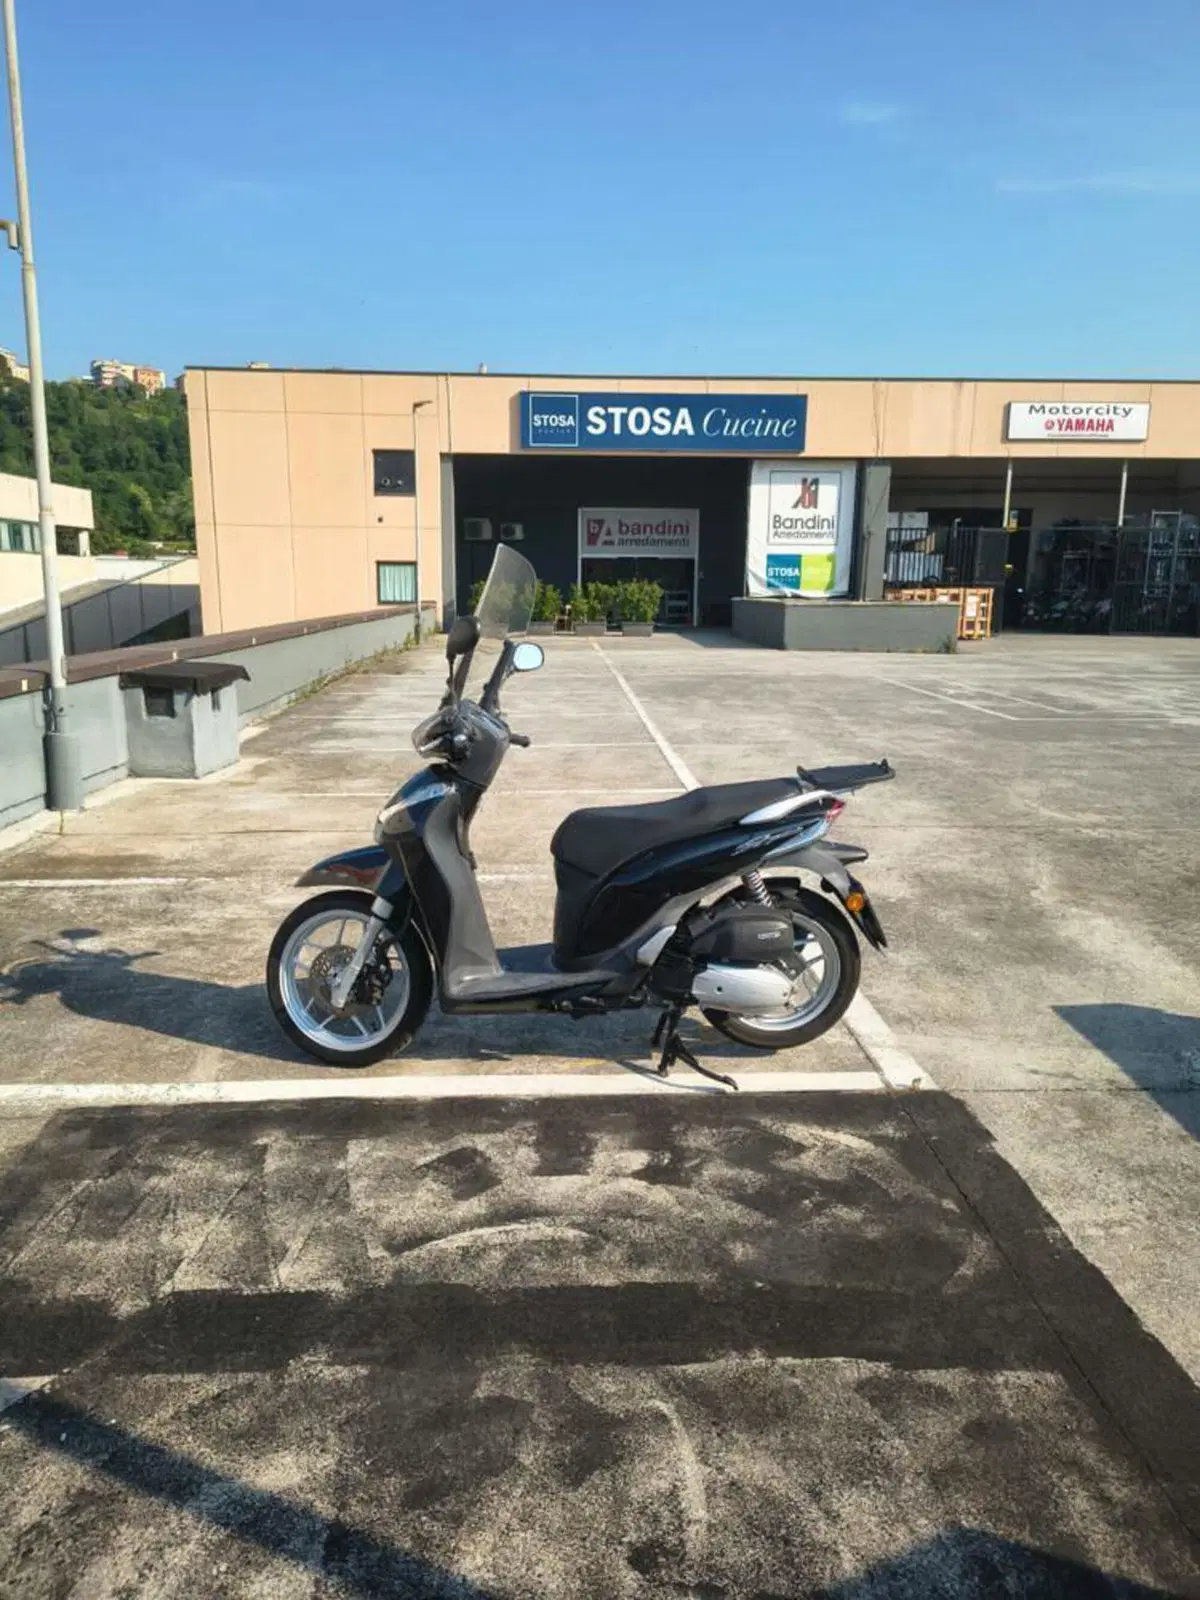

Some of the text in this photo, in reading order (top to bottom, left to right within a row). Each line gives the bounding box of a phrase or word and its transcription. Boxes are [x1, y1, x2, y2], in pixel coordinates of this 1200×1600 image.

[1028, 404, 1133, 418] Motorcity
[533, 414, 576, 427] STOSA
[586, 406, 798, 438] STOSA Cucine
[1056, 418, 1115, 432] YAMAHA
[618, 519, 690, 537] bandini
[773, 514, 835, 530] Bandini
[767, 567, 800, 577] STOSA
